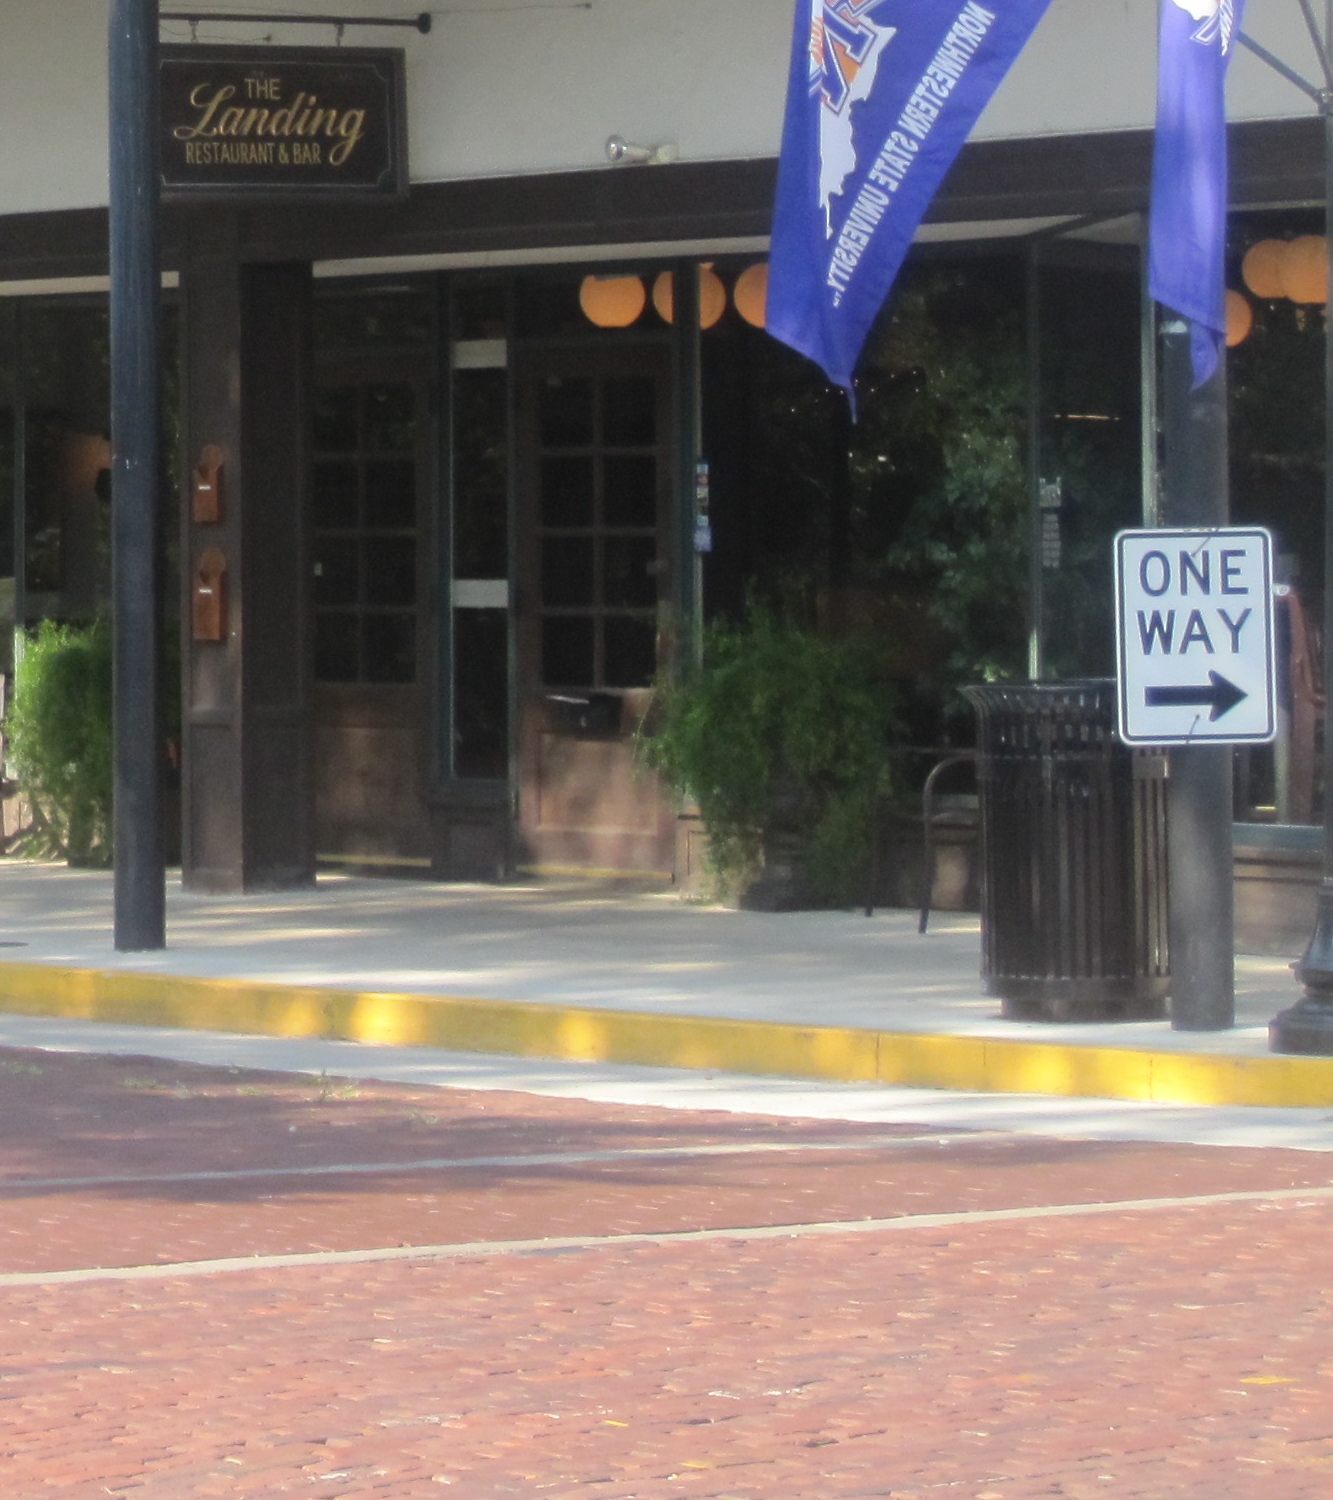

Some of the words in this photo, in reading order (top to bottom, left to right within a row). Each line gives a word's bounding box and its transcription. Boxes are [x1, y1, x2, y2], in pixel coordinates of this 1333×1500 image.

[244, 78, 281, 100] THE
[173, 82, 366, 166] Landing
[186, 142, 275, 164] RESTAURANT
[278, 143, 290, 164] &
[293, 143, 322, 164] BAR
[1140, 550, 1248, 596] ONE
[1137, 608, 1253, 655] WAY
